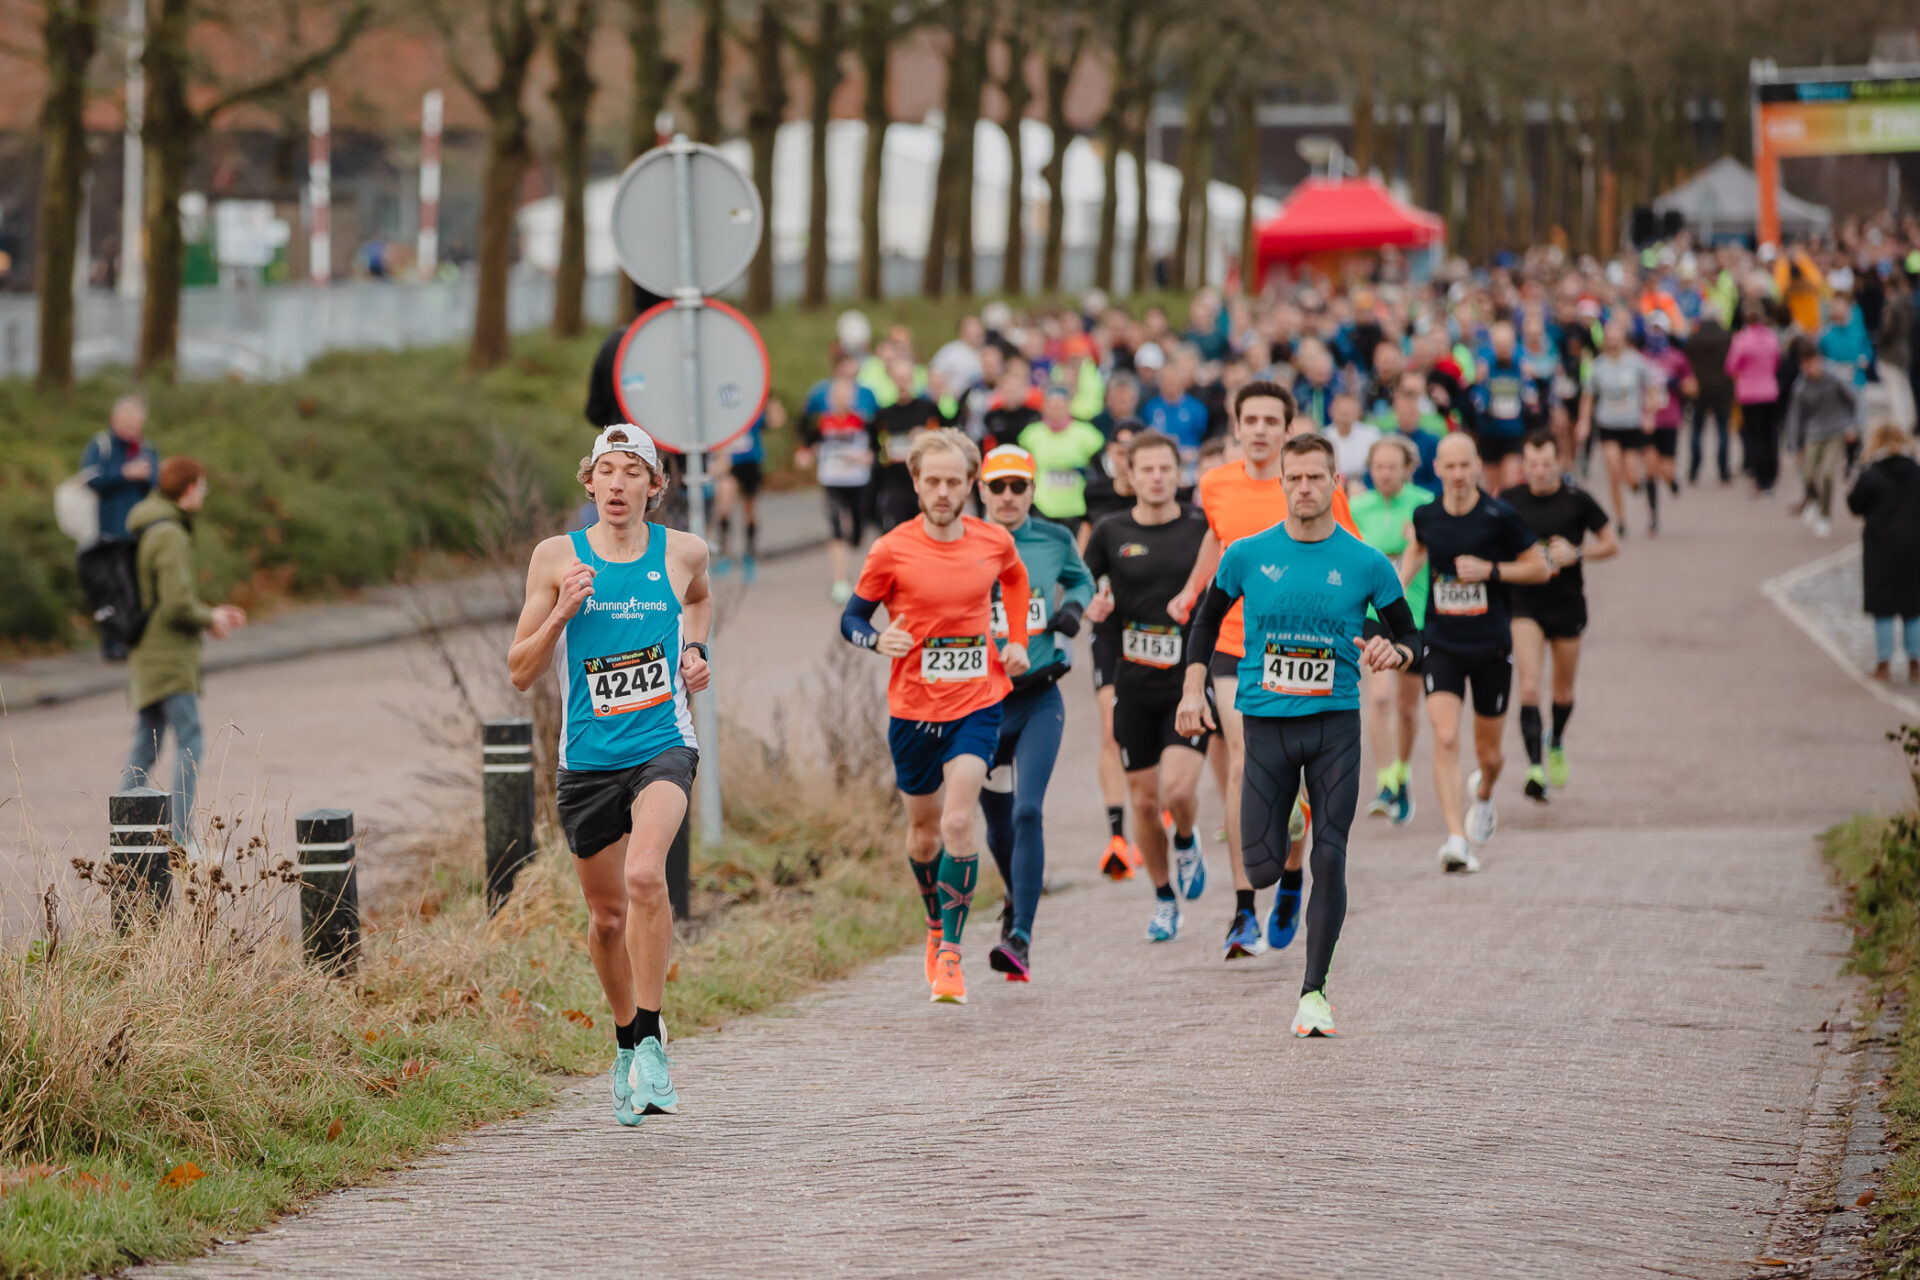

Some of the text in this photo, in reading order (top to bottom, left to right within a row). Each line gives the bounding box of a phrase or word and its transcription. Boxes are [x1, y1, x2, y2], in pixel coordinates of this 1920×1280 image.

[611, 612, 645, 620] company
[1128, 634, 1175, 658] 2153
[927, 649, 982, 671] 2328
[1269, 658, 1329, 682] 4102
[595, 663, 665, 699] 4242
